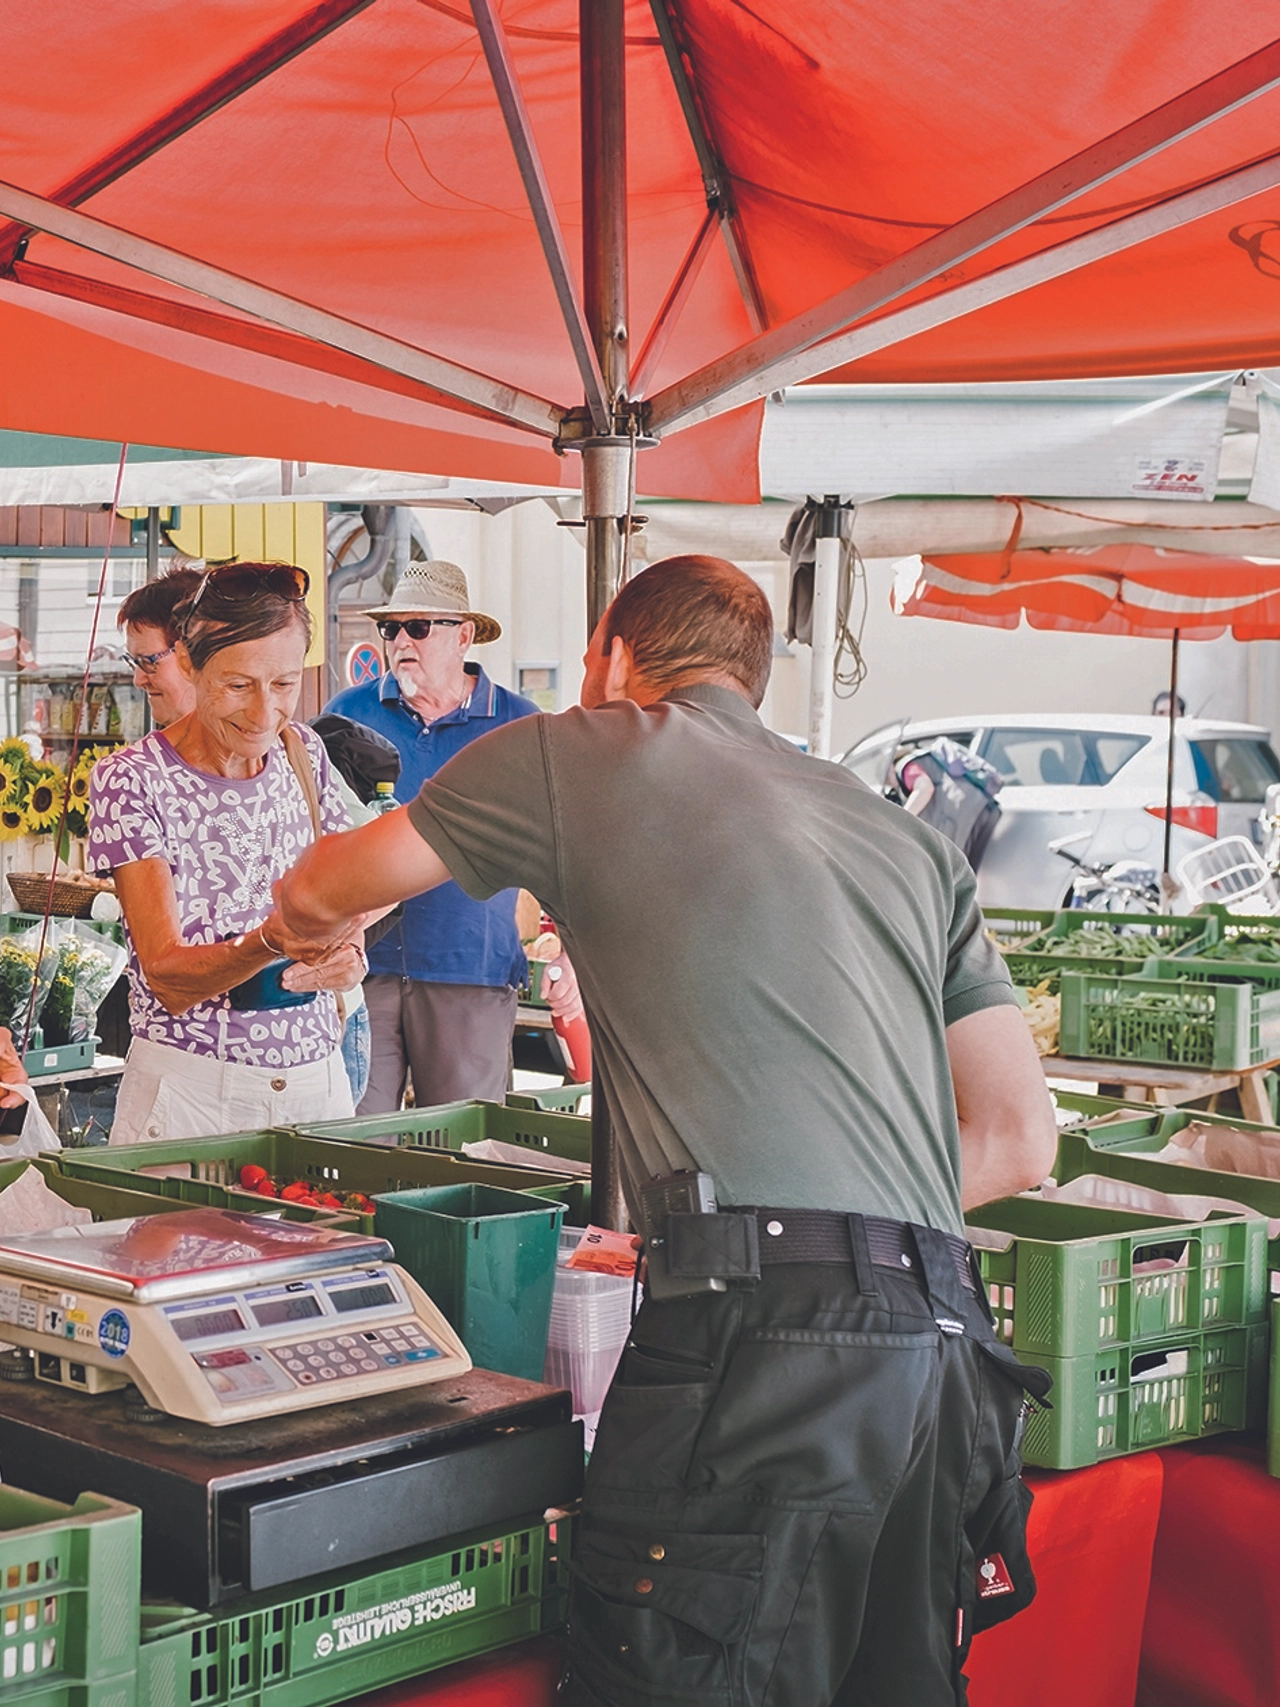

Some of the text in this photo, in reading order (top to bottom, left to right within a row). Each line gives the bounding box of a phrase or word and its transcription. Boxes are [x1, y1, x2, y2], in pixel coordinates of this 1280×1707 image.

[587, 1233, 602, 1244] 10
[100, 1320, 129, 1343] 2018
[414, 1586, 476, 1626] FRISCHE
